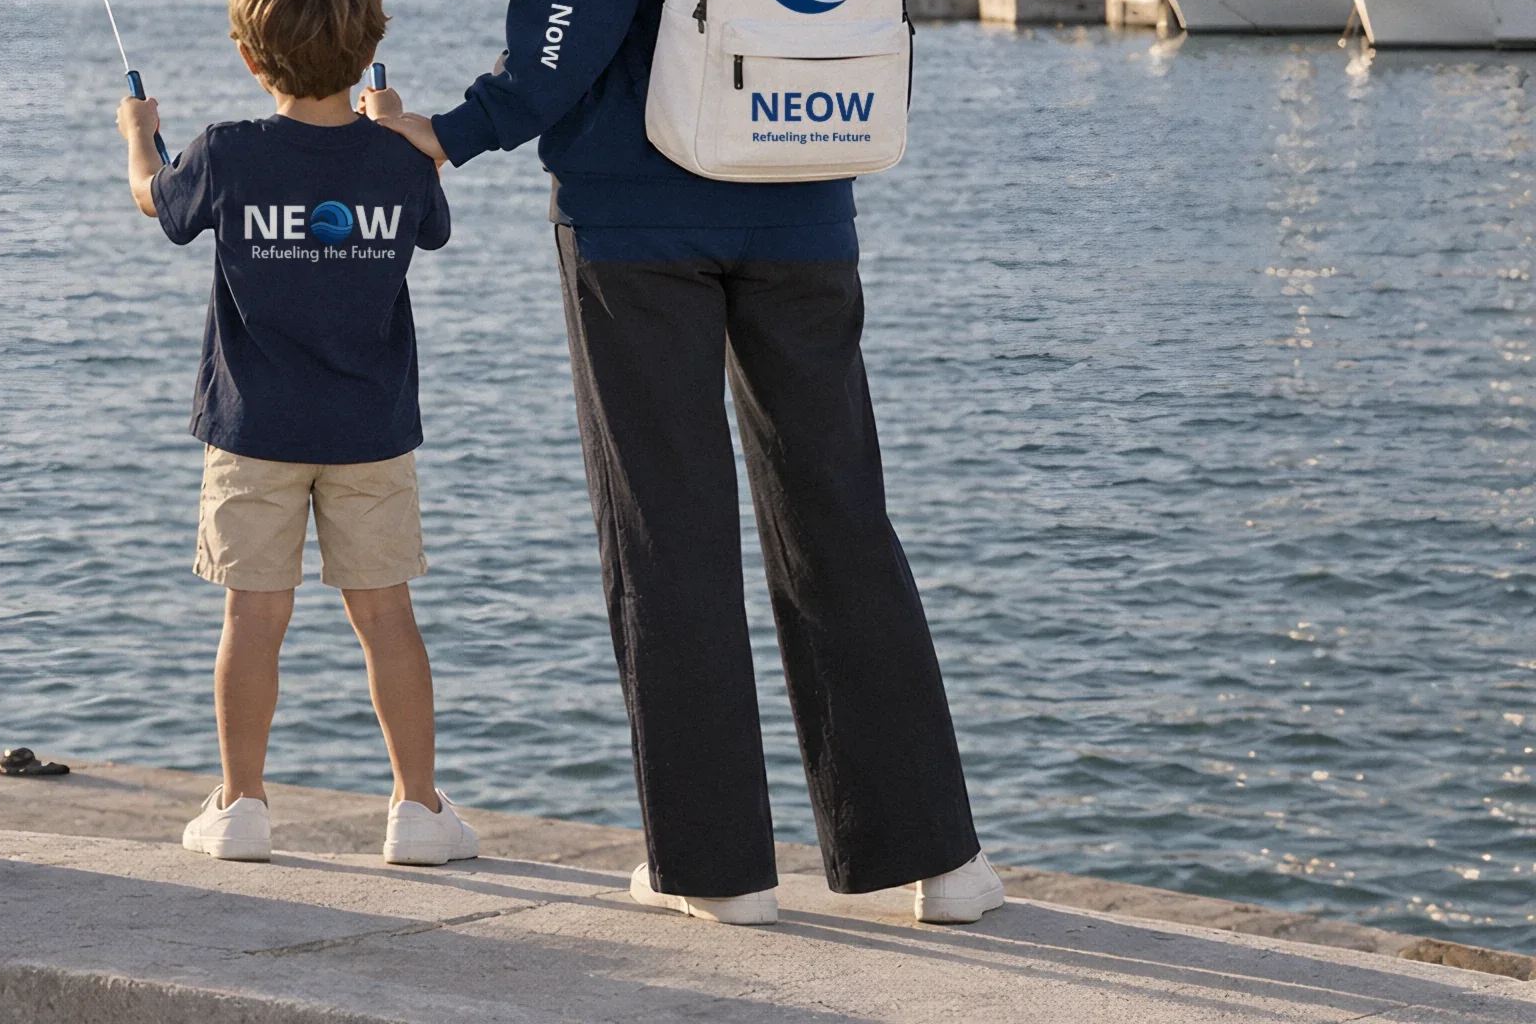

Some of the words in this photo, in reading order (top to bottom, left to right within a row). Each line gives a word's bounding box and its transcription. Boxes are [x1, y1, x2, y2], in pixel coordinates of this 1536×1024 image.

[540, 3, 573, 70] Now
[751, 91, 875, 122] NEOW
[752, 132, 807, 144] Refueling
[810, 132, 829, 142] the
[832, 132, 871, 142] Future
[251, 245, 319, 262] Refueling
[324, 246, 347, 259] the
[351, 245, 396, 259] Future
